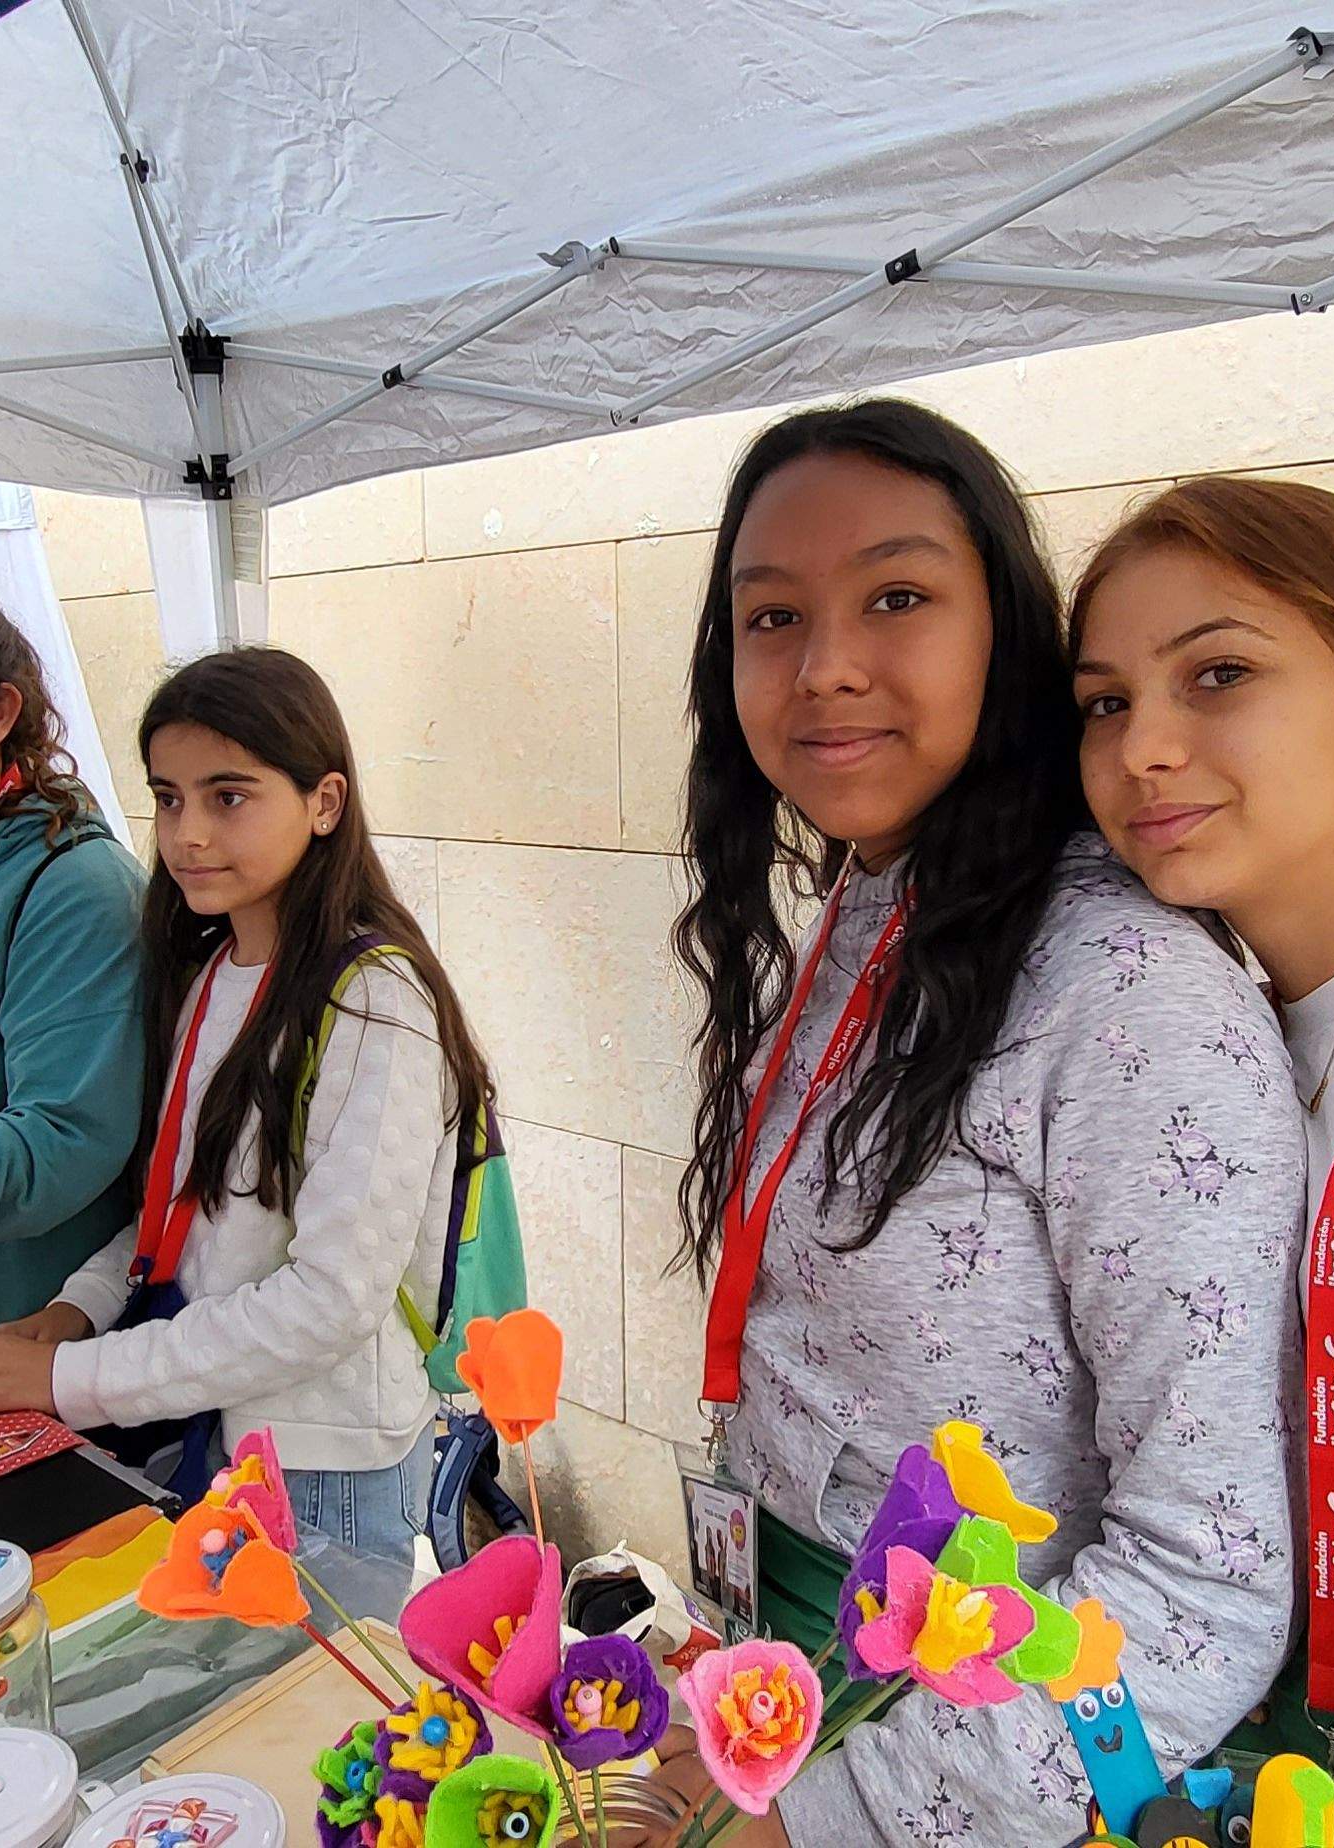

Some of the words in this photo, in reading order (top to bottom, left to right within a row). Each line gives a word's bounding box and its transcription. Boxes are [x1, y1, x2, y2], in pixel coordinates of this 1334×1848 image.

[1314, 1217, 1331, 1286] Fundación
[1312, 1376, 1327, 1445] Fundación
[1314, 1531, 1328, 1599] Fundación
